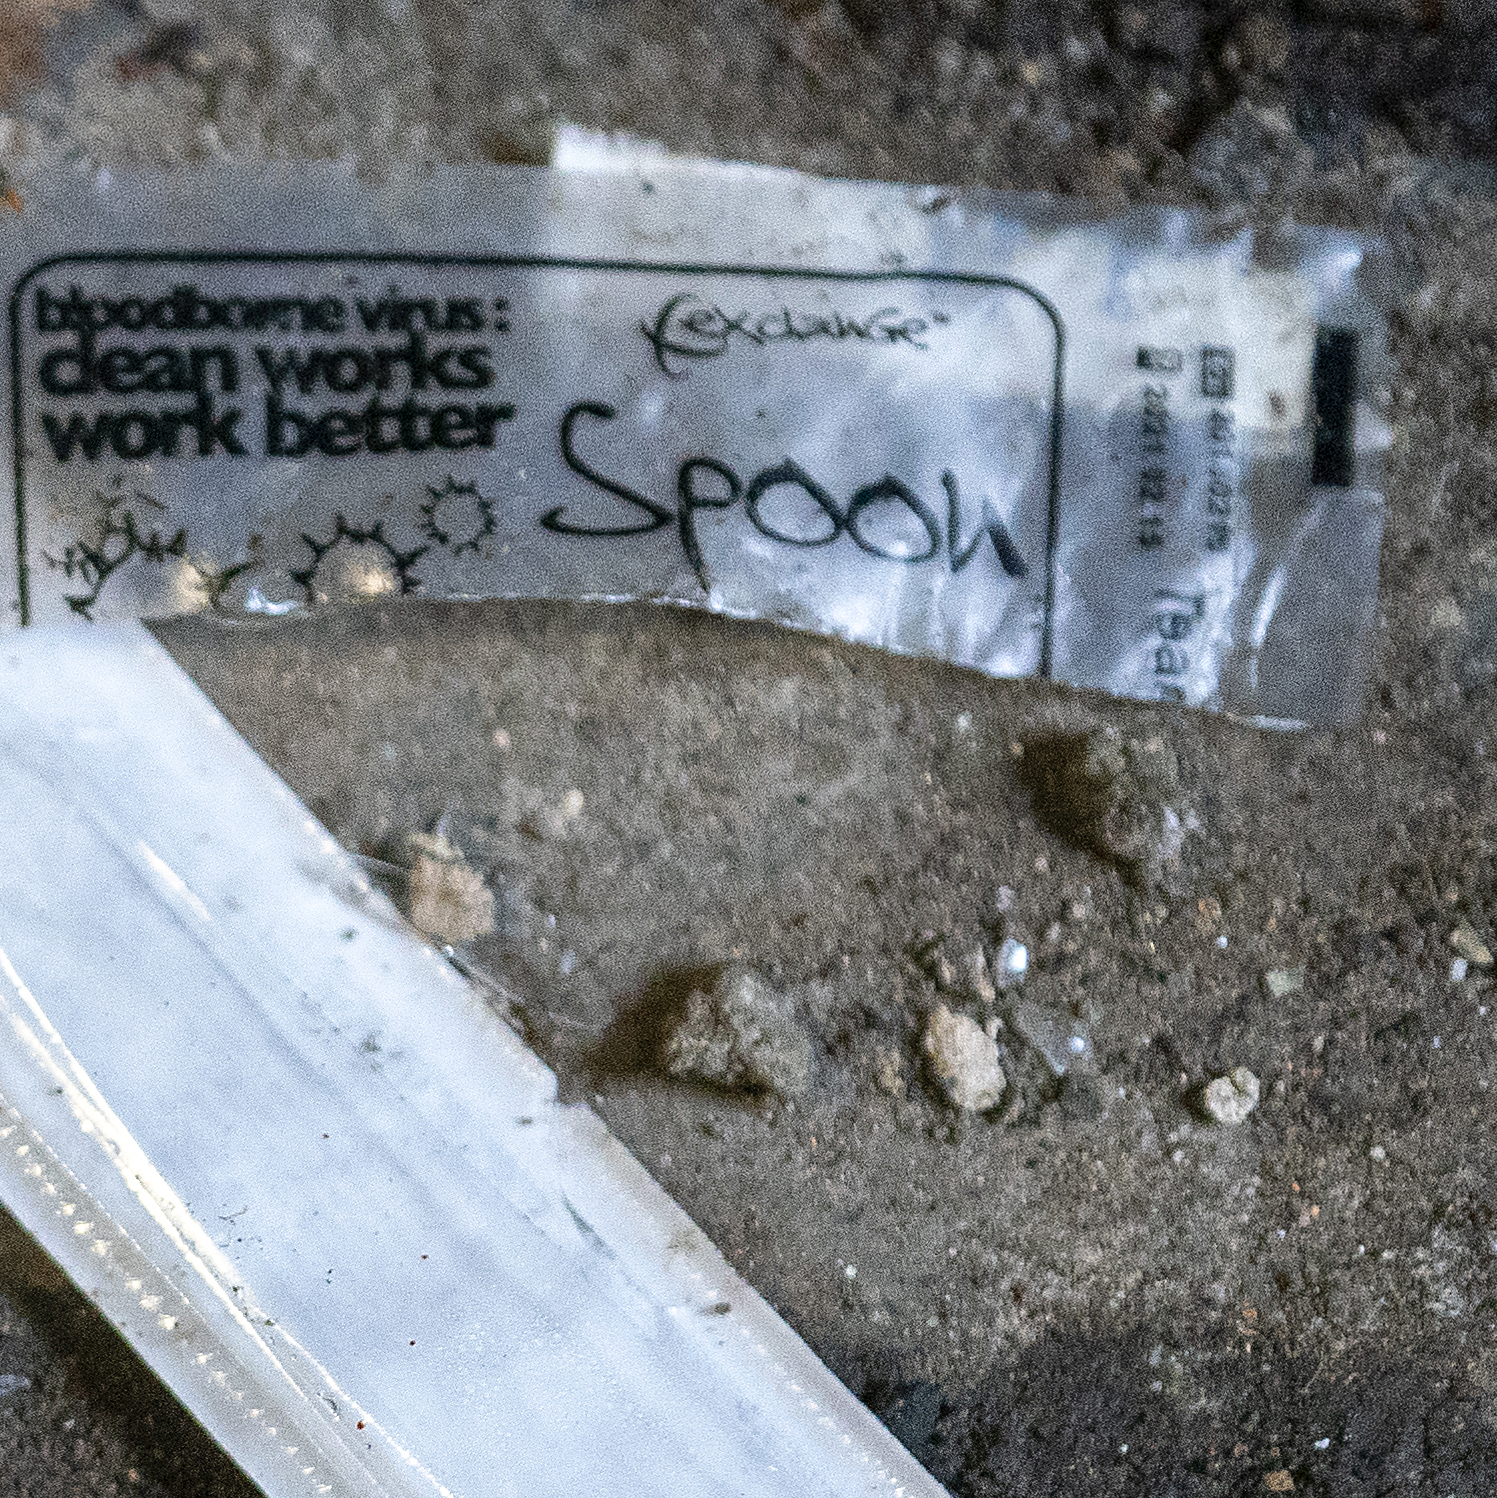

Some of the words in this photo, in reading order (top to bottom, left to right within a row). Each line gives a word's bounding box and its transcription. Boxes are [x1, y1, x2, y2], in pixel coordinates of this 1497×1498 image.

[35, 282, 346, 333] bloodborne
[357, 286, 510, 333] virus:
[255, 328, 496, 394] works
[41, 388, 248, 462] work
[264, 386, 516, 456] better
